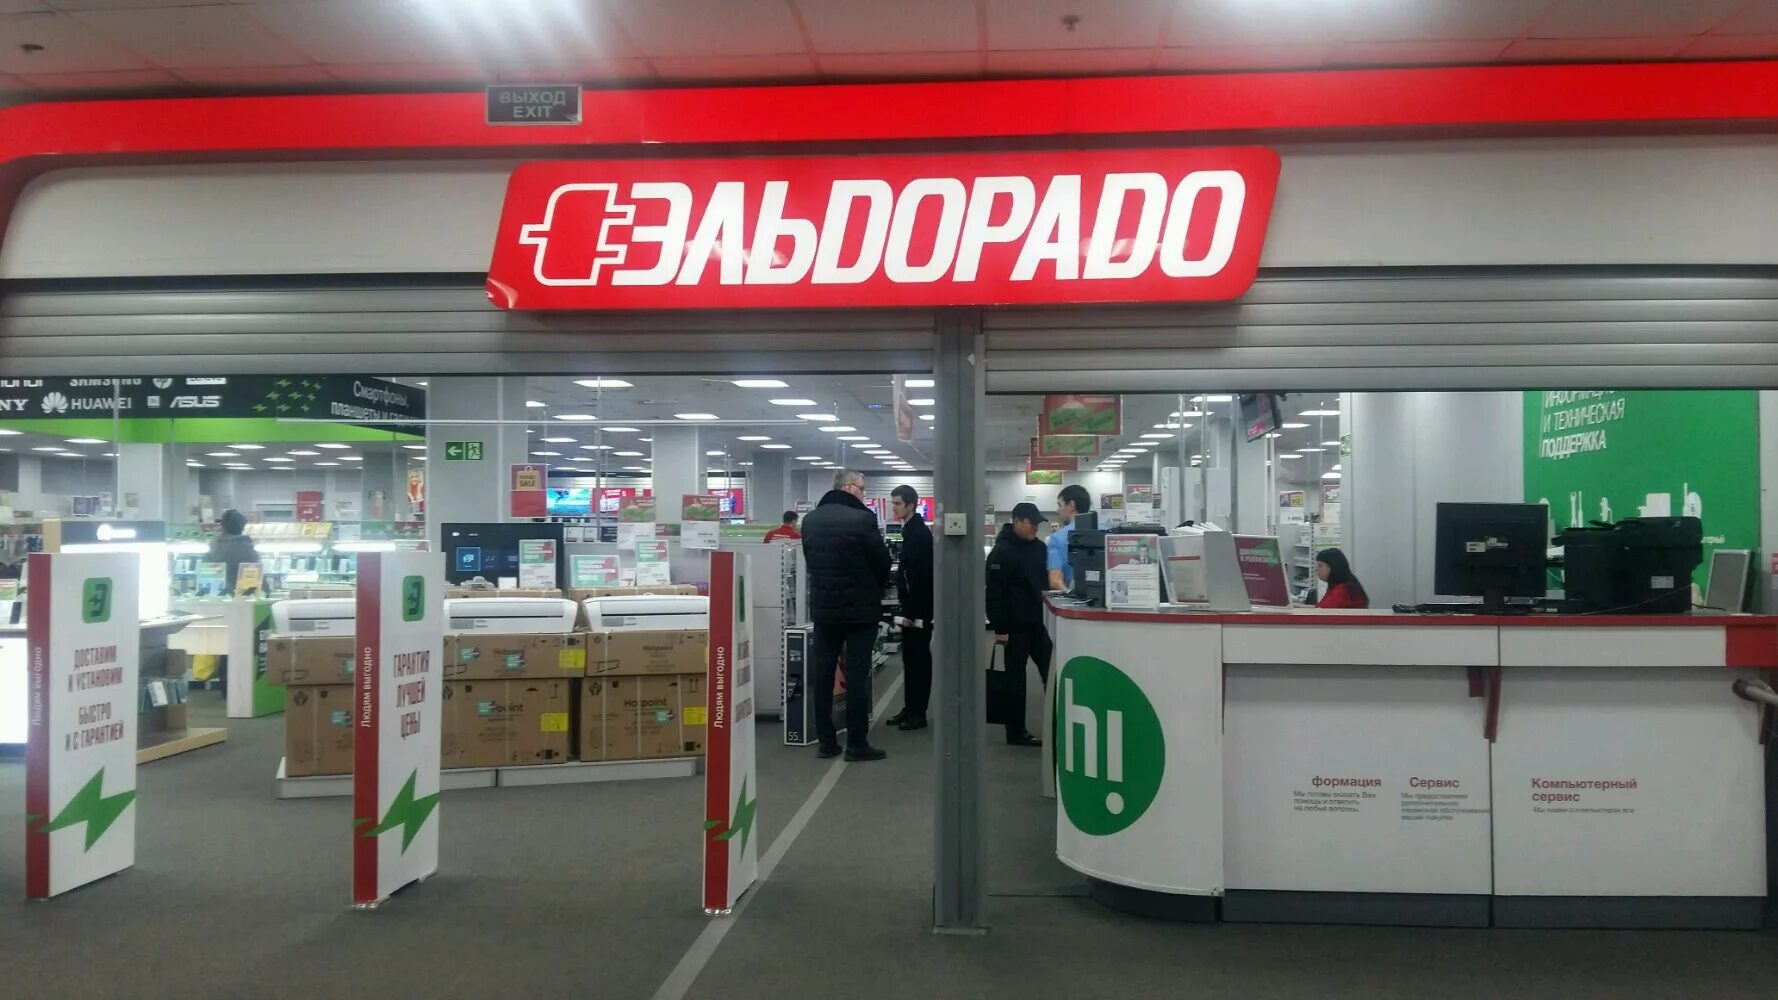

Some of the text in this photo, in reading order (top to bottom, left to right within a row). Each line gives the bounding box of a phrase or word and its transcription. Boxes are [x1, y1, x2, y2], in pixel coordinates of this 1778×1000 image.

[500, 91, 566, 106] ВЫХОД
[512, 105, 553, 118] EXIT
[71, 397, 132, 410] HUAWEI
[169, 395, 221, 408] ASUS
[353, 380, 410, 409] Смартфоны,
[1543, 397, 1625, 433] И ТЕХНИЧЕСКАЯ
[1541, 429, 1607, 460] ПОДДЕРЖКА
[74, 645, 117, 669] ДОСТАВИМ
[393, 650, 430, 678] ГАРАНТИЯ
[32, 647, 43, 726] Людям выгодно
[68, 668, 123, 692] И УСТАНОВИМ
[361, 646, 373, 728] Людям выгодно
[713, 646, 725, 729] Людям выгодно
[396, 677, 426, 708] ЛУЧШЕЙ
[624, 699, 668, 709] Hopoint
[79, 702, 112, 726] БЫСТРО
[400, 711, 421, 740] ЦЕНЫ
[65, 719, 124, 751] И С ГАРАНТИЕЙ
[1064, 677, 1125, 815] hi!
[1311, 776, 1382, 788] формация
[1409, 776, 1461, 789] Сервис
[1531, 778, 1638, 791] Компьютерный
[1532, 793, 1581, 803] сервис
